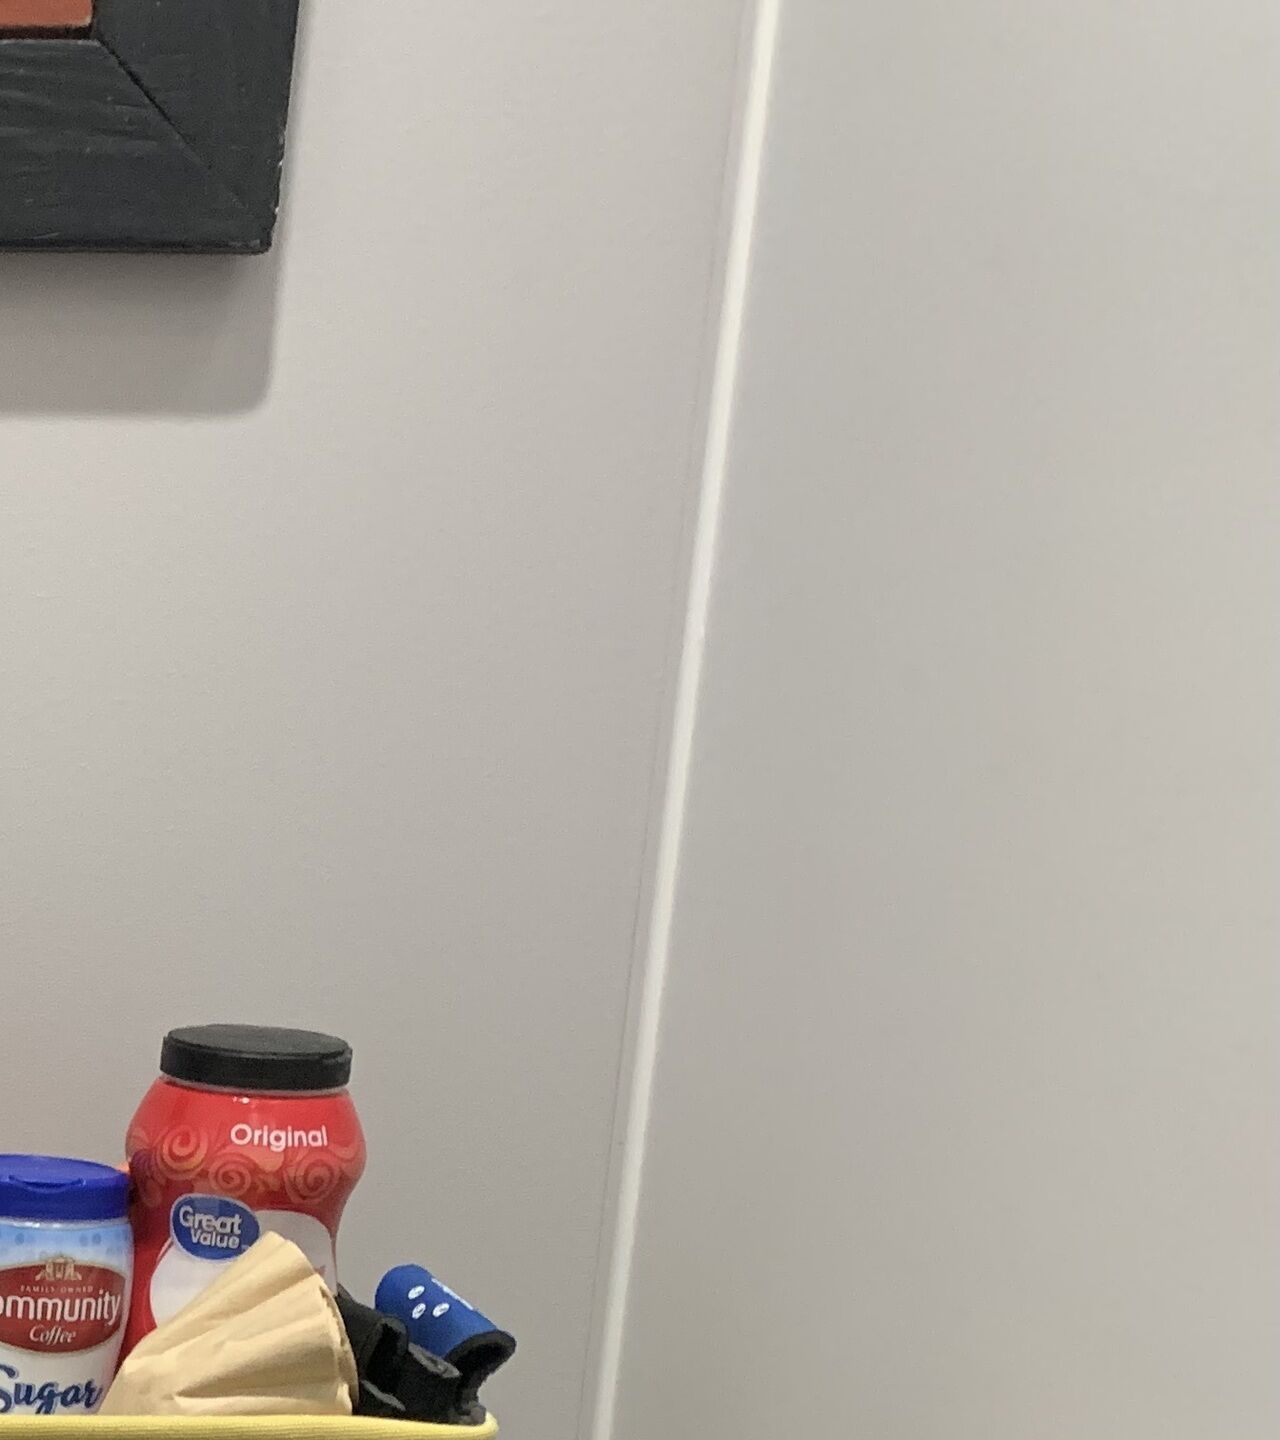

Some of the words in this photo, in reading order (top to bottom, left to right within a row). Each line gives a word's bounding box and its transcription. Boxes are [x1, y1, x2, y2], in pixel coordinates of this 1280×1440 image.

[230, 1123, 327, 1152] Original
[179, 1205, 242, 1234] Great
[190, 1229, 240, 1249] Value
[20, 1285, 55, 1294] FAMILY
[30, 1324, 77, 1346] Coffee
